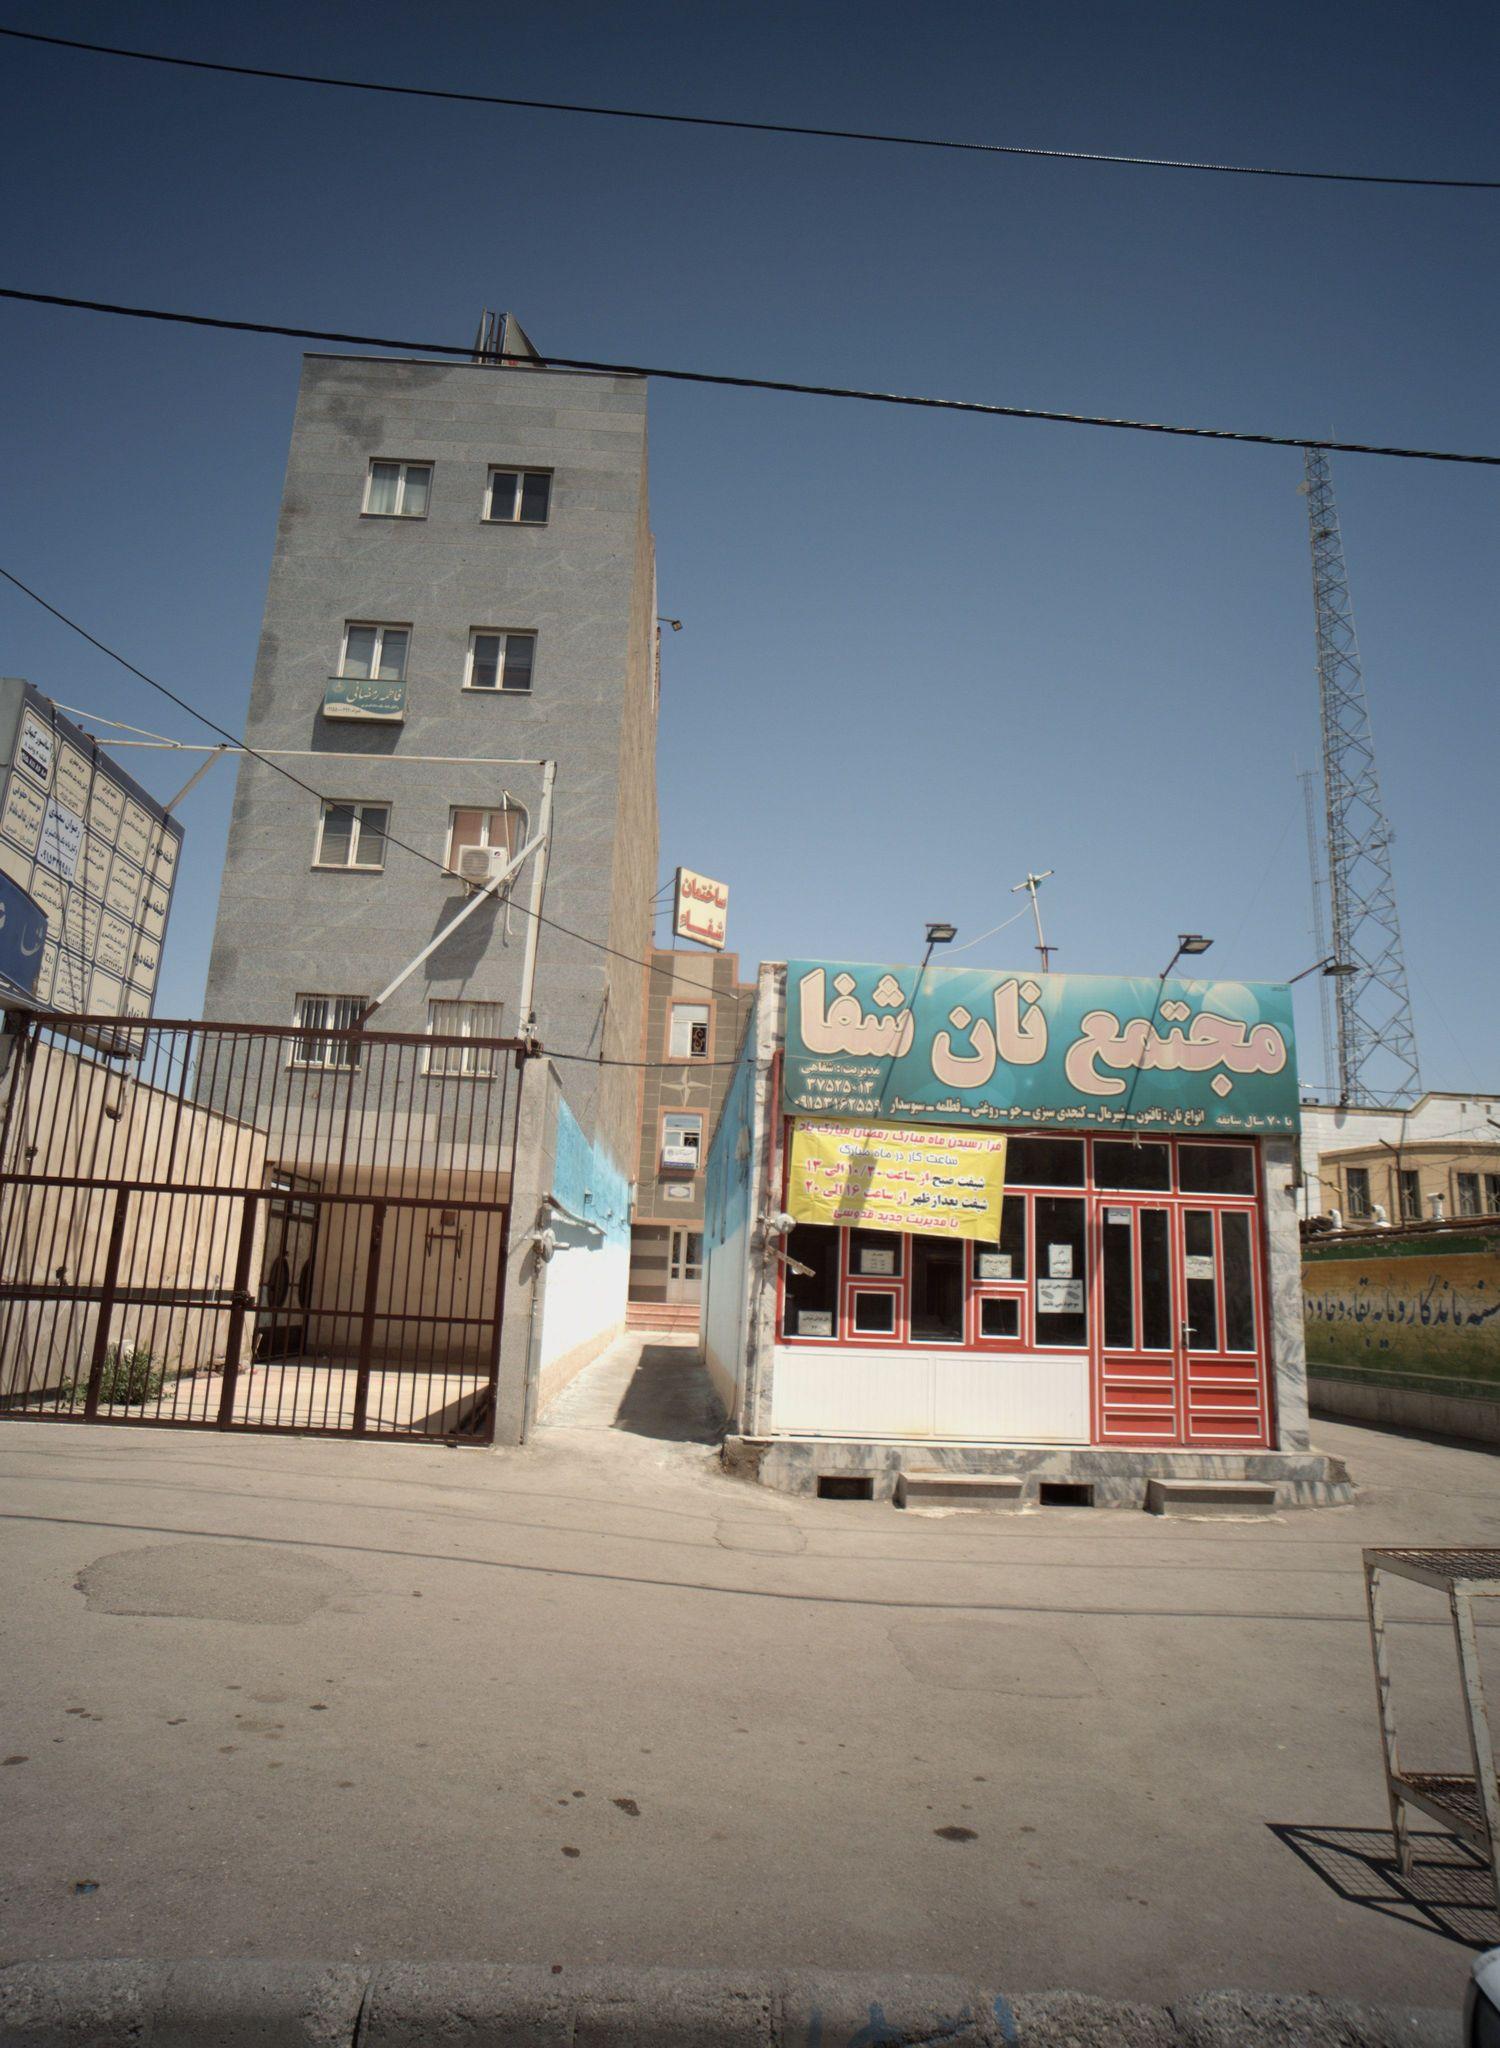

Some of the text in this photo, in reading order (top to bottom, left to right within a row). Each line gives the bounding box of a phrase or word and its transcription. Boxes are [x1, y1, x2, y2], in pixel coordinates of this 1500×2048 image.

[682, 877, 728, 910] ساختمان
[797, 967, 1287, 1097] مجتمع نان شفا
[800, 1061, 834, 1074] شفاهی
[970, 1100, 999, 1118] روغنی
[1056, 1104, 1087, 1122] کنجدی
[1097, 1104, 1126, 1124] شیرمال
[1135, 1105, 1161, 1125] تافتون
[1183, 1108, 1205, 1126] انواع
[799, 1120, 1002, 1152] فرا رسیدن ماه مبارک رمضان مبارک باد
[838, 1144, 959, 1167] ساعت کار در ماه مبارک
[824, 1161, 844, 1177] الی
[886, 1169, 916, 1183] ساعت
[919, 1171, 930, 1186] از
[931, 1174, 955, 1189] صبح
[957, 1175, 986, 1189] شیفت
[822, 1182, 842, 1198] الی
[863, 1186, 894, 1200] ساعت
[896, 1189, 907, 1205] از
[960, 1196, 988, 1211] شیفت
[876, 1211, 903, 1224] جدید
[905, 1212, 947, 1228] مدیریت
[949, 1218, 959, 1228] با
